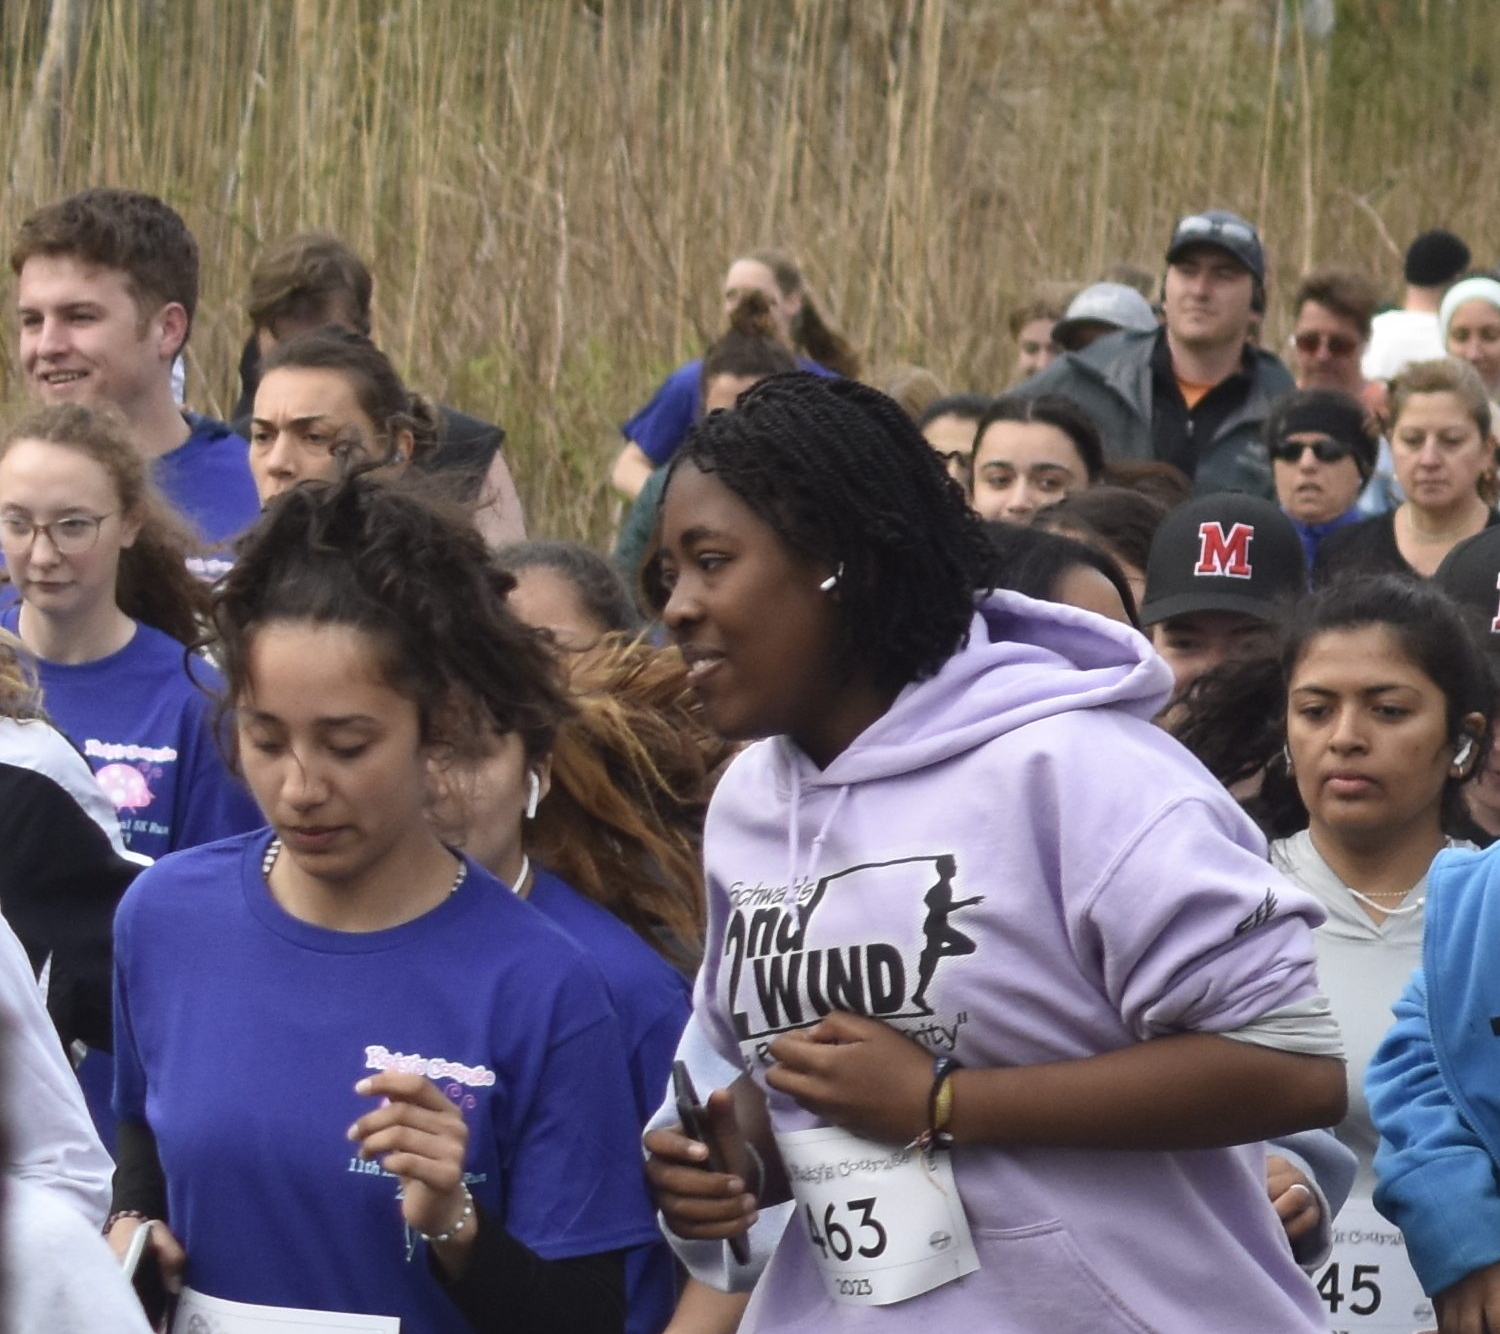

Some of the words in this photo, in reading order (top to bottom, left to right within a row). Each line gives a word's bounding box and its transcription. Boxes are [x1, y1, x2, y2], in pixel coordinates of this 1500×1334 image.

[1194, 521, 1255, 580] M
[753, 942, 906, 1029] WIND
[806, 1196, 888, 1262] 463
[1350, 1229, 1405, 1246] Coura
[1316, 1261, 1382, 1316] 45
